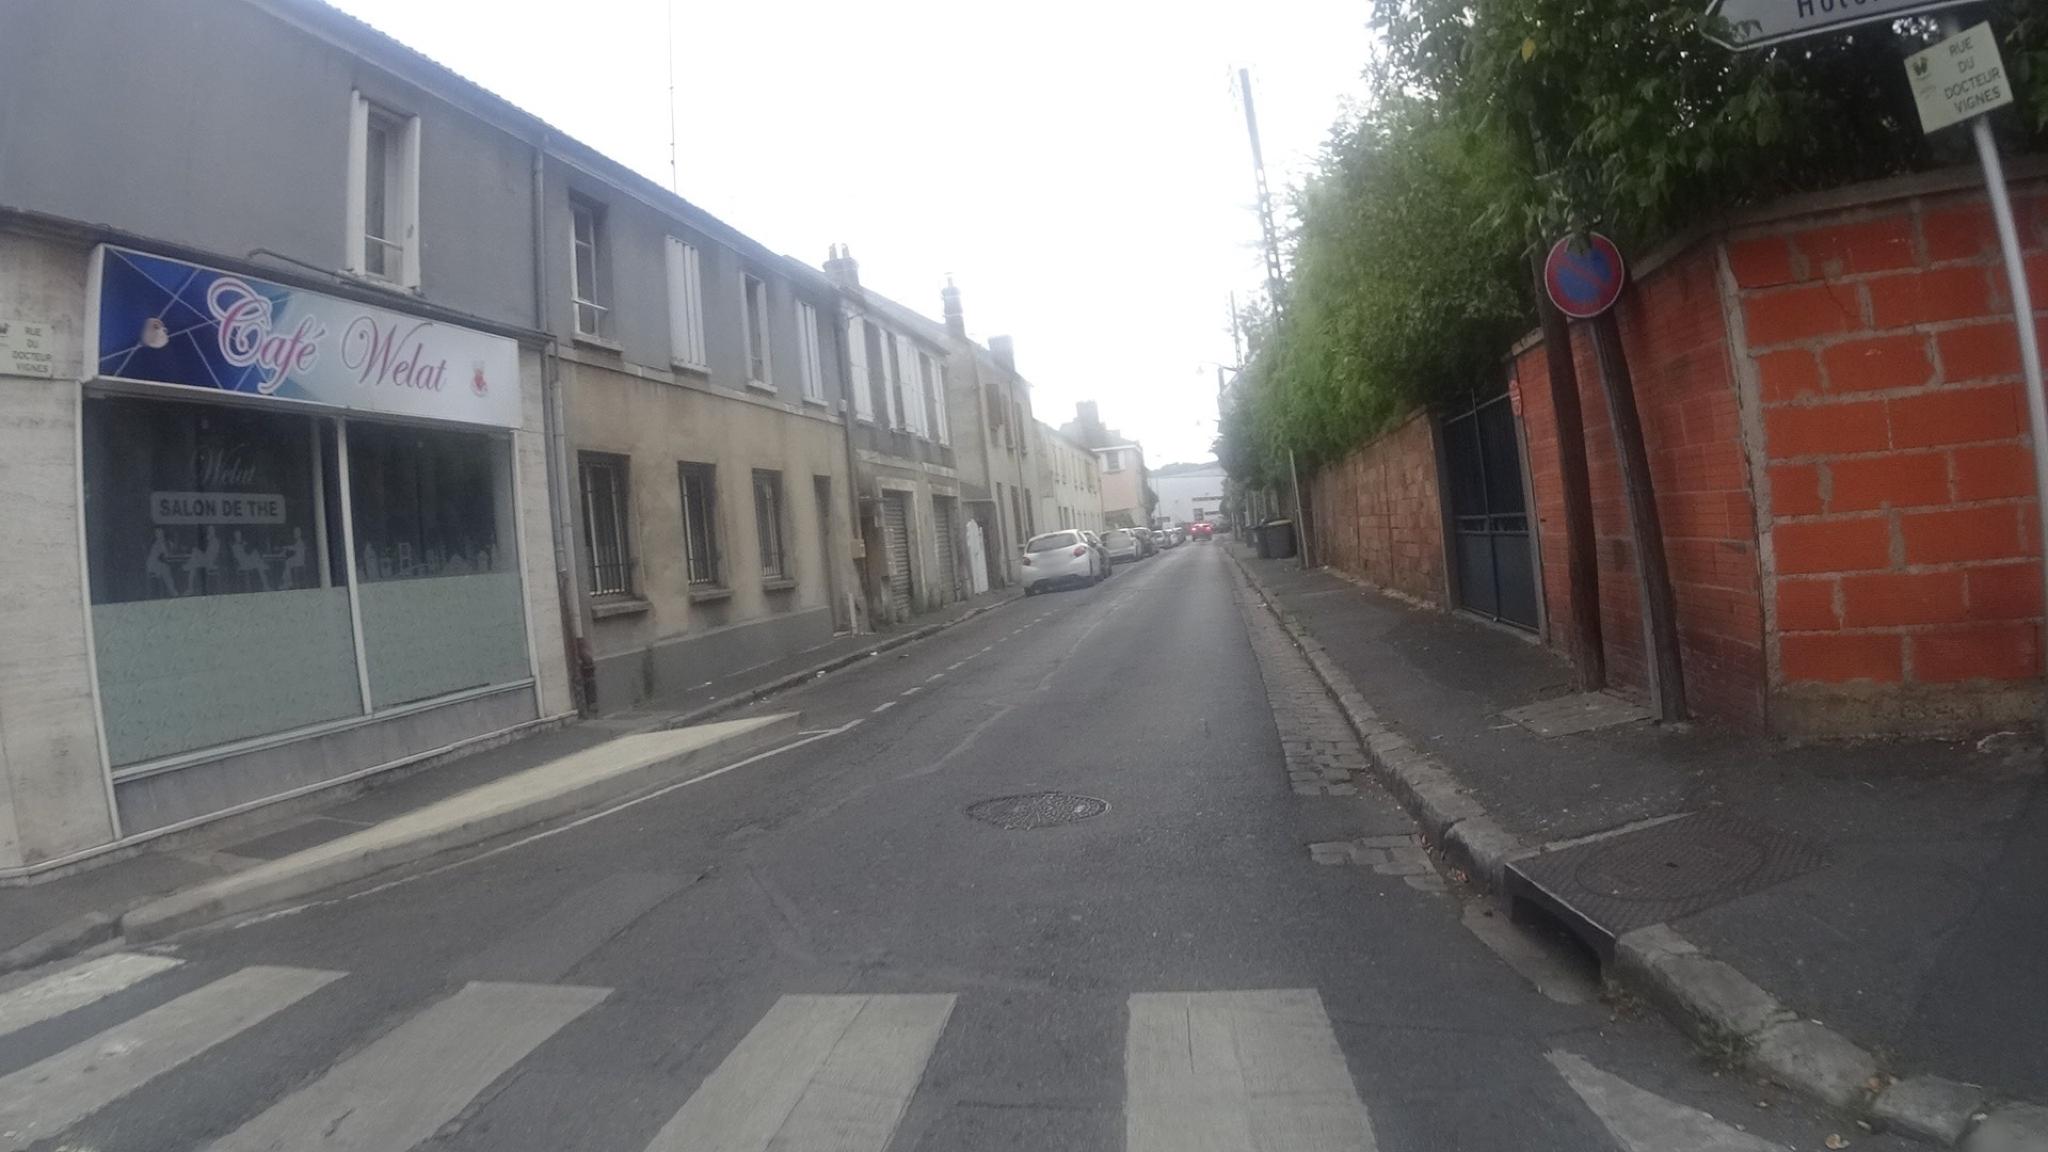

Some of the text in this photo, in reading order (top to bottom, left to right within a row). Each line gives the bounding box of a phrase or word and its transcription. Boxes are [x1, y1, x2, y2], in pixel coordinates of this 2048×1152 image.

[1949, 37, 1973, 56] RUE
[1958, 57, 1975, 73] DU
[1944, 66, 2001, 99] DOCTEUR
[1954, 86, 2001, 113] VIGNES
[207, 277, 448, 393] Café Welat
[159, 498, 216, 517] SALON
[221, 499, 242, 517] DE
